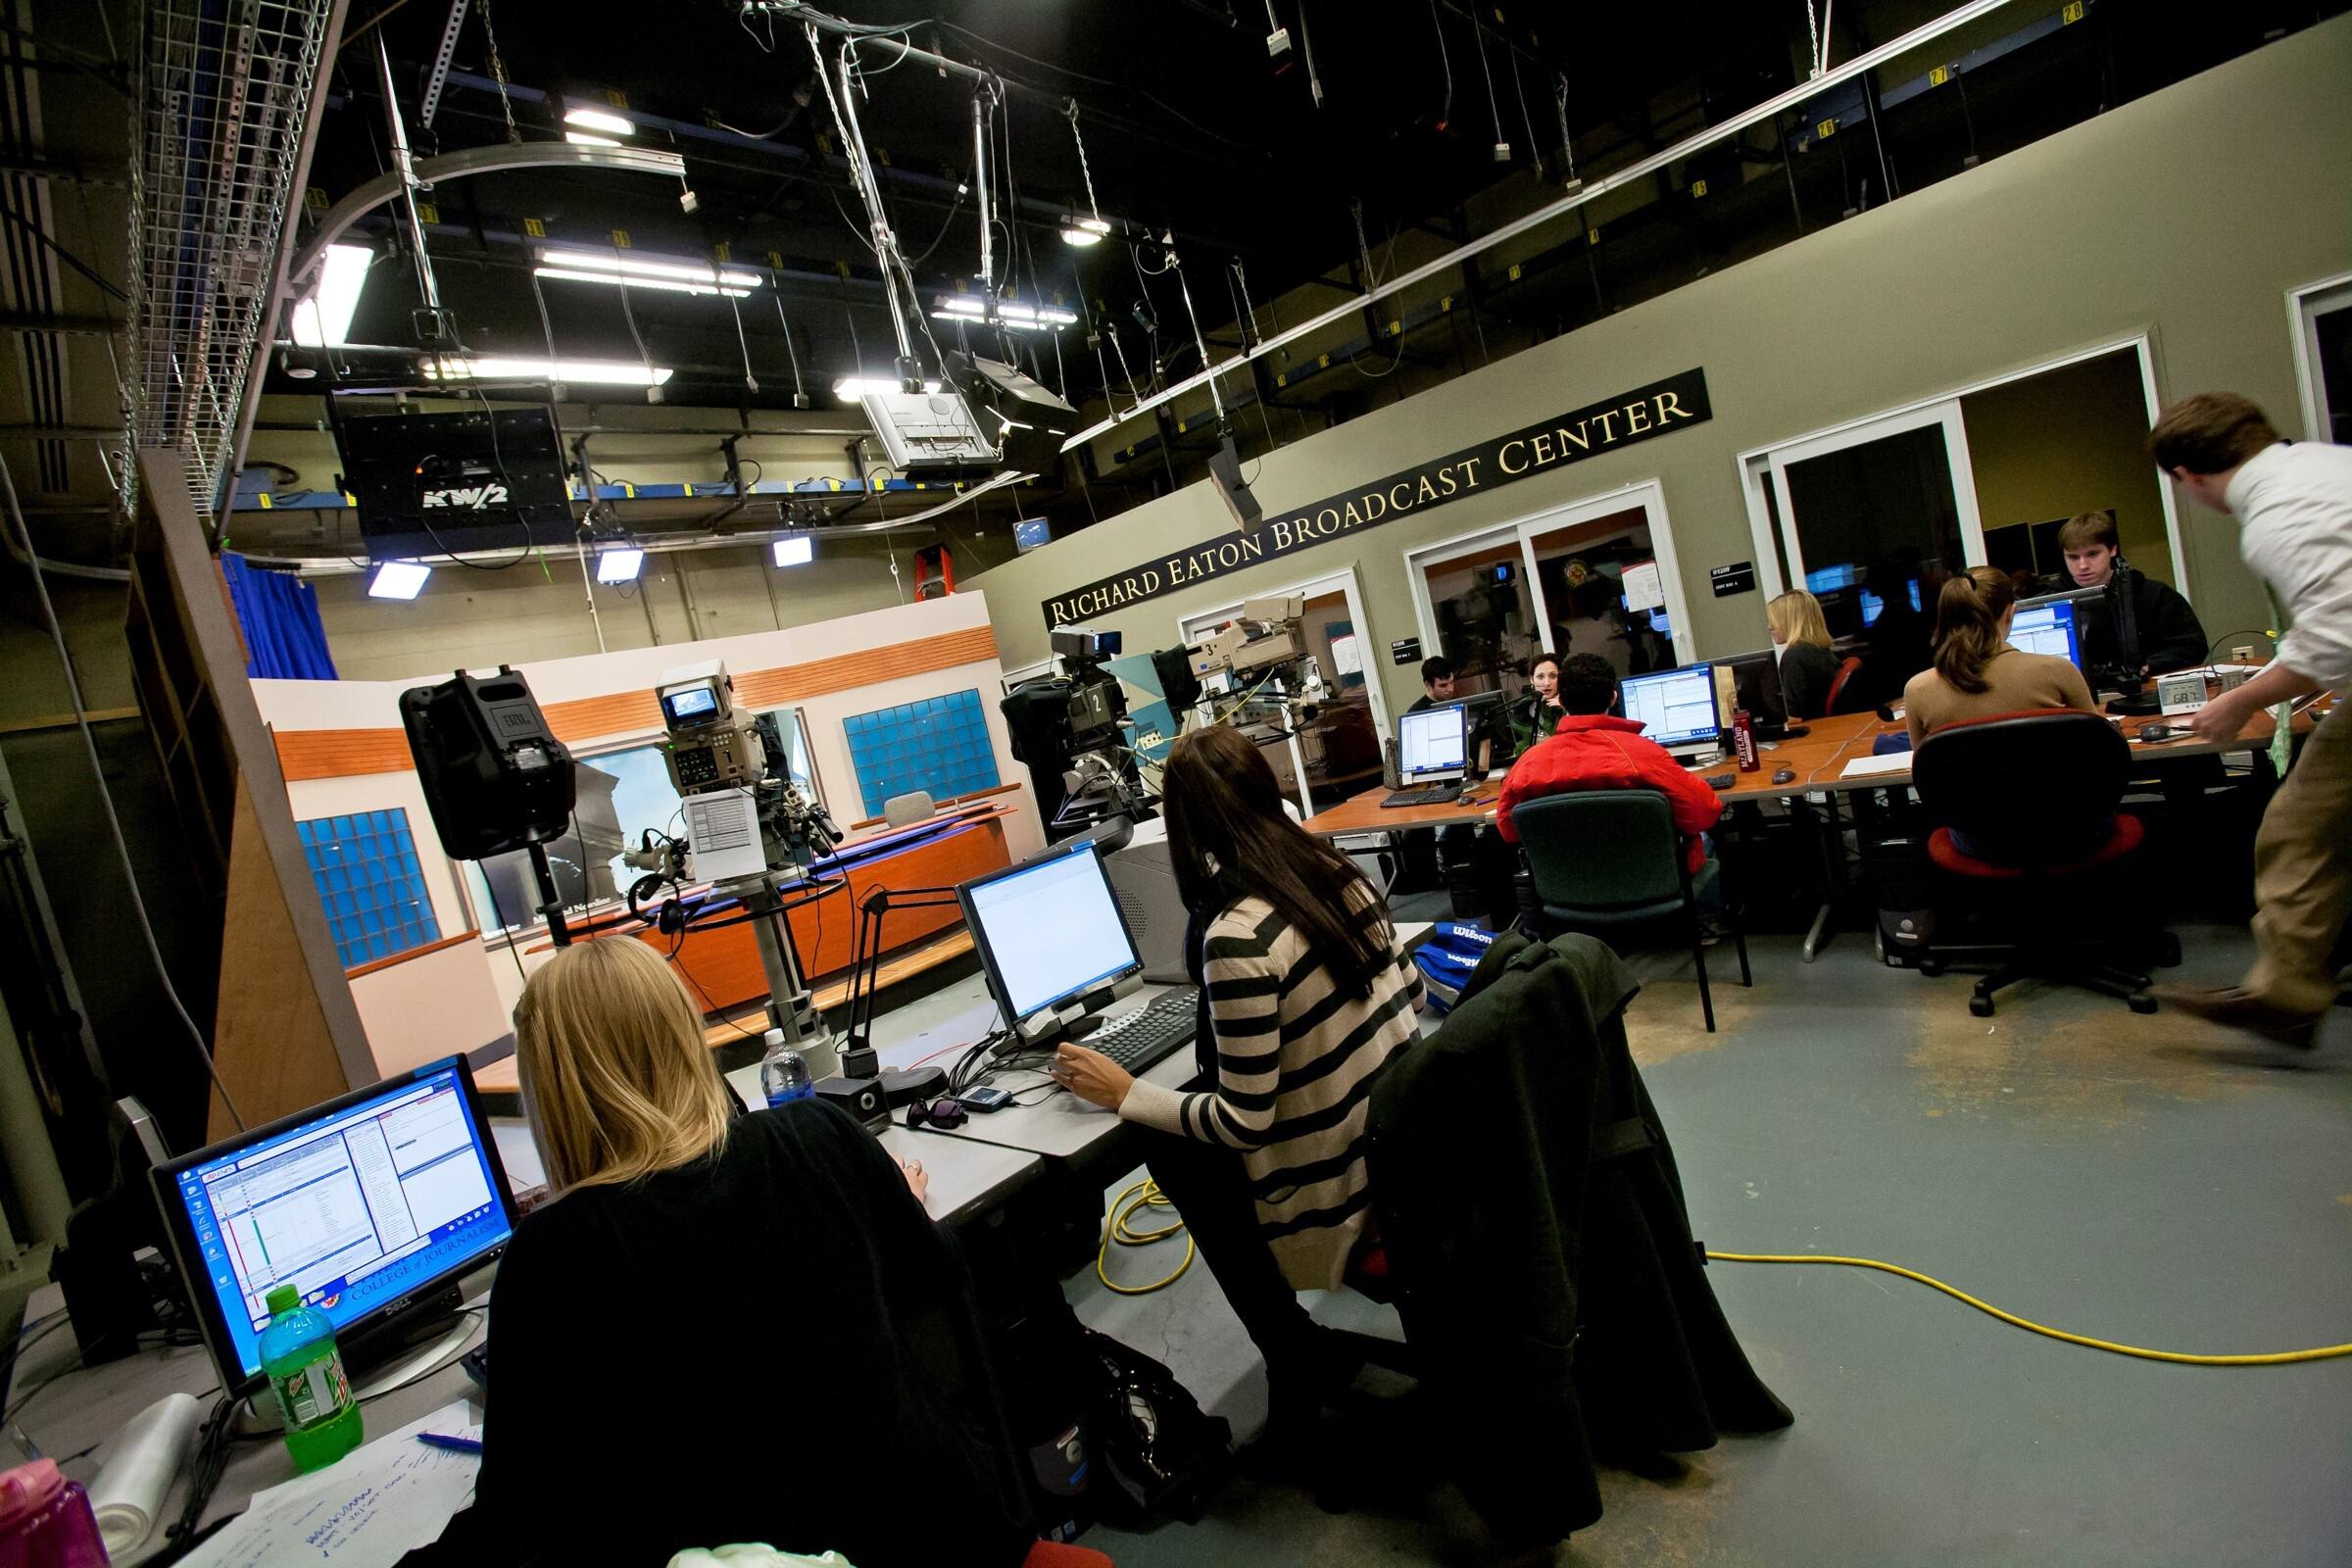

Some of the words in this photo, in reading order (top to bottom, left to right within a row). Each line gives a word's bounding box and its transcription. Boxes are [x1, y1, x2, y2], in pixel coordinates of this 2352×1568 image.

[2064, 3, 2082, 23] 28
[1932, 67, 1946, 84] 27
[1819, 121, 1834, 136] 26
[422, 483, 508, 510] KW/2
[1051, 571, 1160, 624] RICHARD
[1166, 534, 1262, 585] EATON
[1270, 458, 1481, 551] BROADCAST
[1498, 392, 1693, 474] CENTER
[1205, 643, 1213, 657] 3
[1092, 694, 1102, 712] 2
[1734, 726, 1748, 767] MARYLAND
[351, 1264, 411, 1300] COLLEGE
[423, 1218, 499, 1265] JOURNALISM
